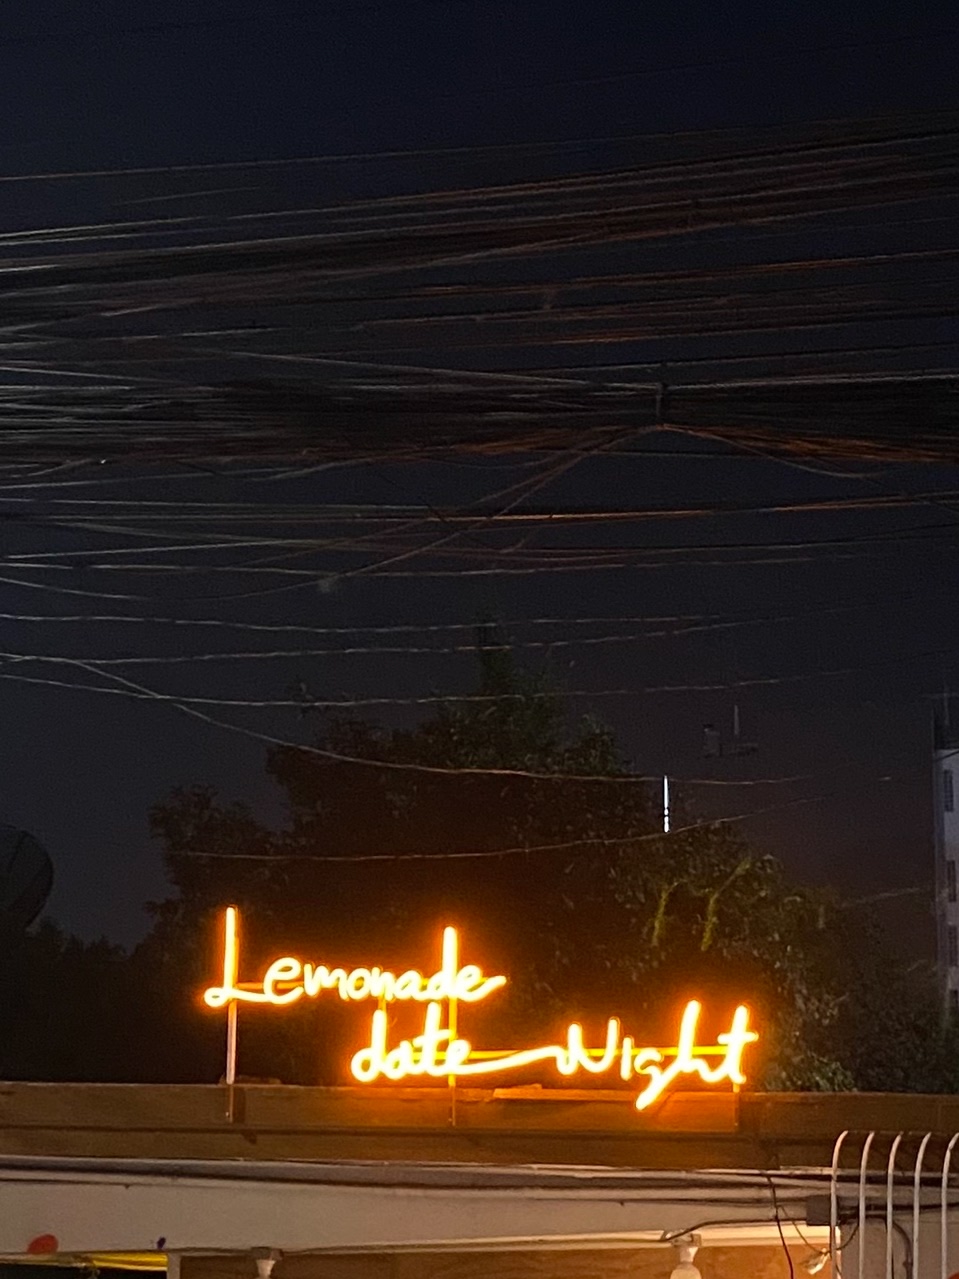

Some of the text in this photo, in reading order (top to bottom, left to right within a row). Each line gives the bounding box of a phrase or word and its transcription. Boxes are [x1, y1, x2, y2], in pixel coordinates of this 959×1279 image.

[203, 906, 507, 1007] Lemonade
[350, 1000, 759, 1111] date Night
